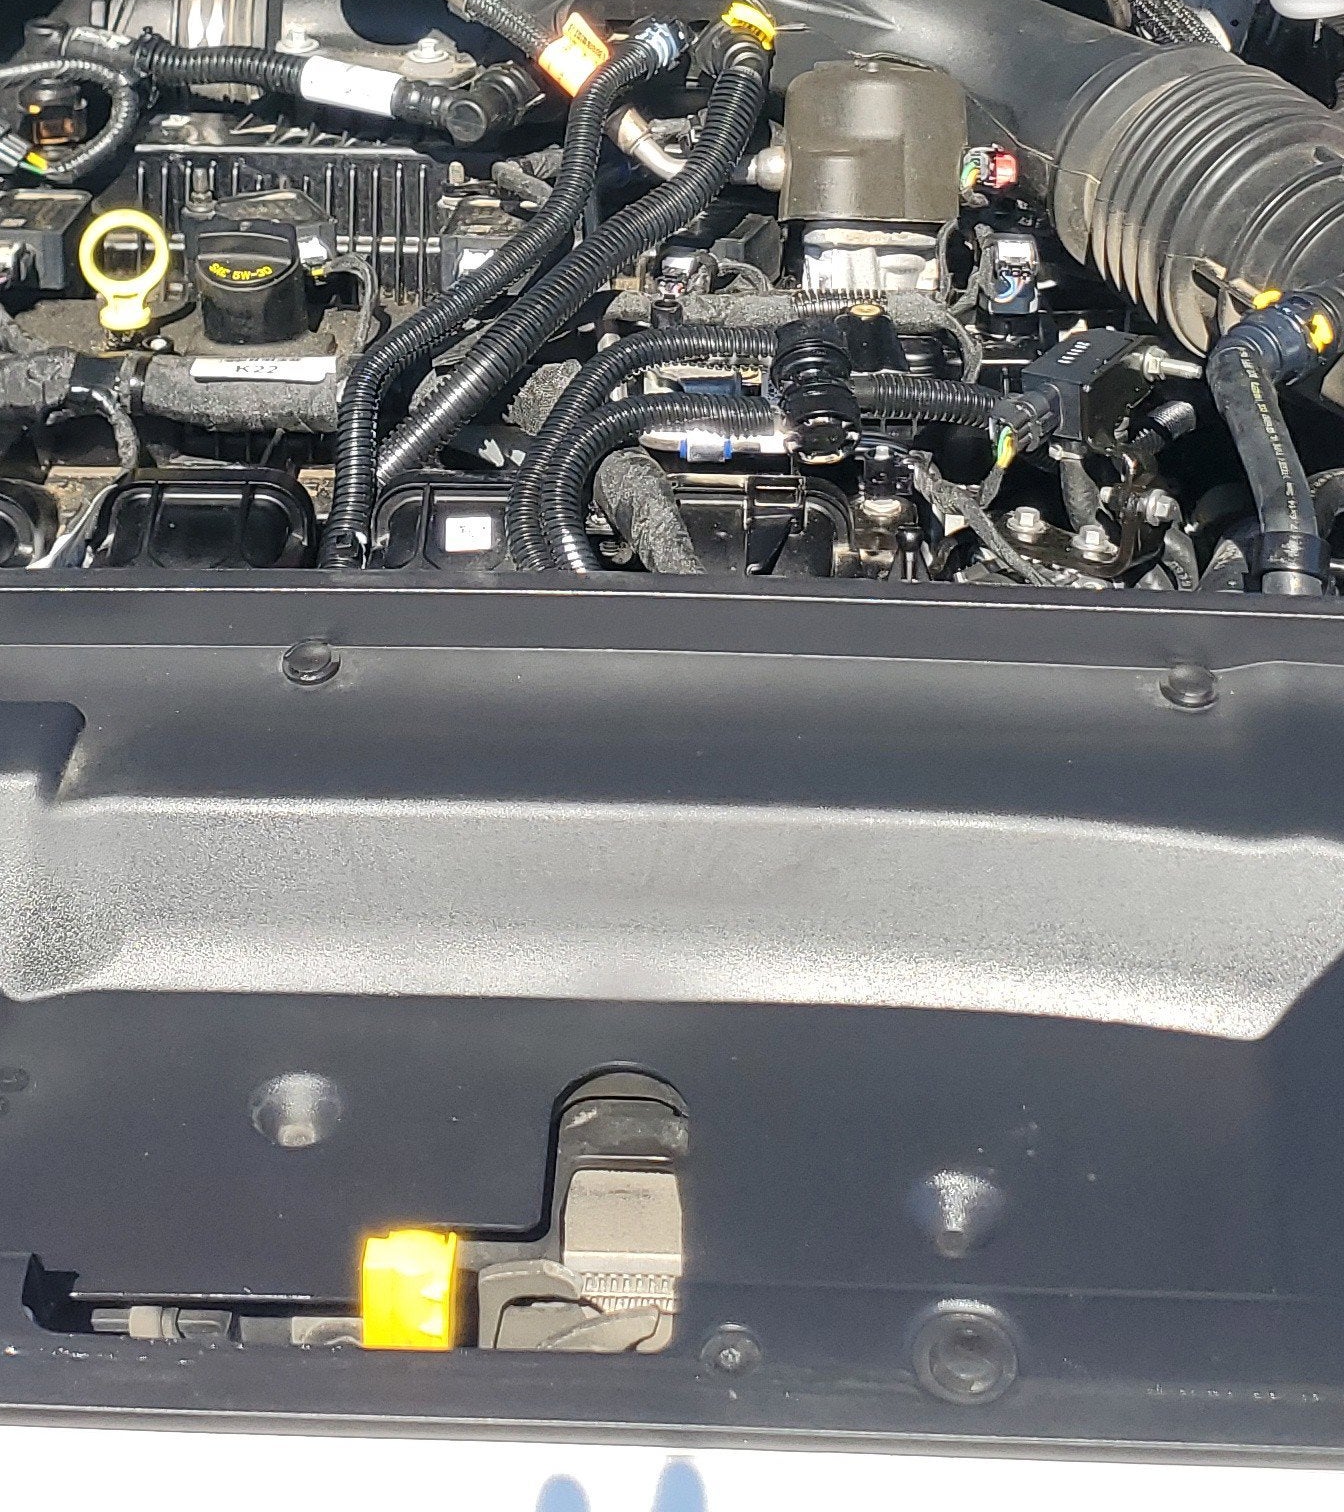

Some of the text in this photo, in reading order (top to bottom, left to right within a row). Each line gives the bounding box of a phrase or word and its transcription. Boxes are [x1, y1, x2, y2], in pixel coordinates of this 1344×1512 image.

[208, 262, 273, 281] SAE 5W-30
[235, 364, 279, 375] K22
